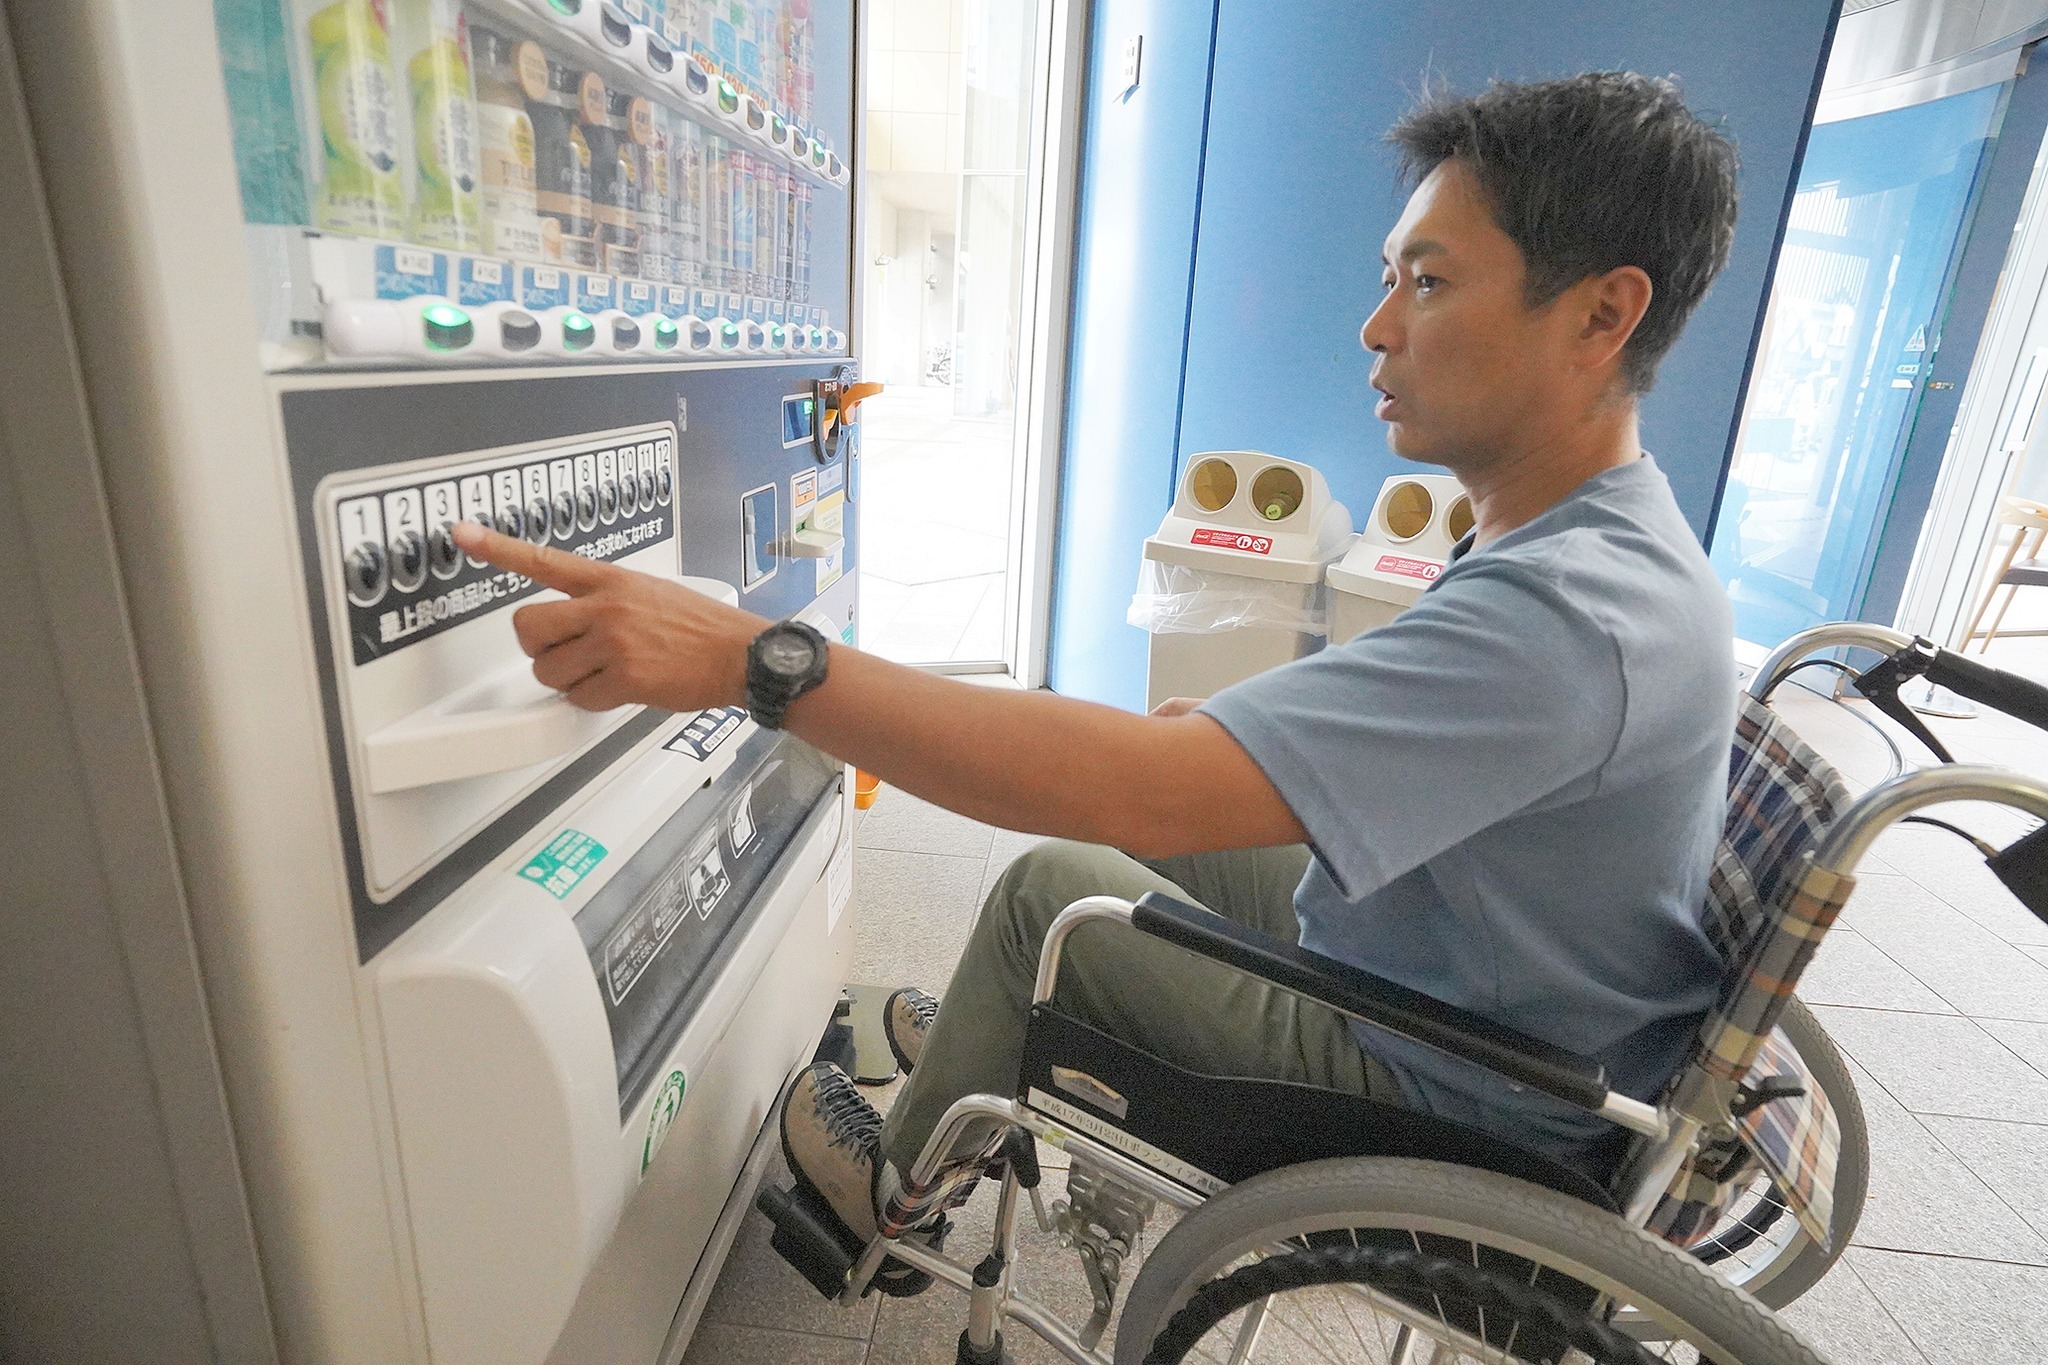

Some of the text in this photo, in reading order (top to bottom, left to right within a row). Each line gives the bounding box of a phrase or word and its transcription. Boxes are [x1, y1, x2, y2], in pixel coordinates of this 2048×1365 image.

[355, 443, 669, 535] 1 2 3 4 5 6 7 8 9 10 11 12
